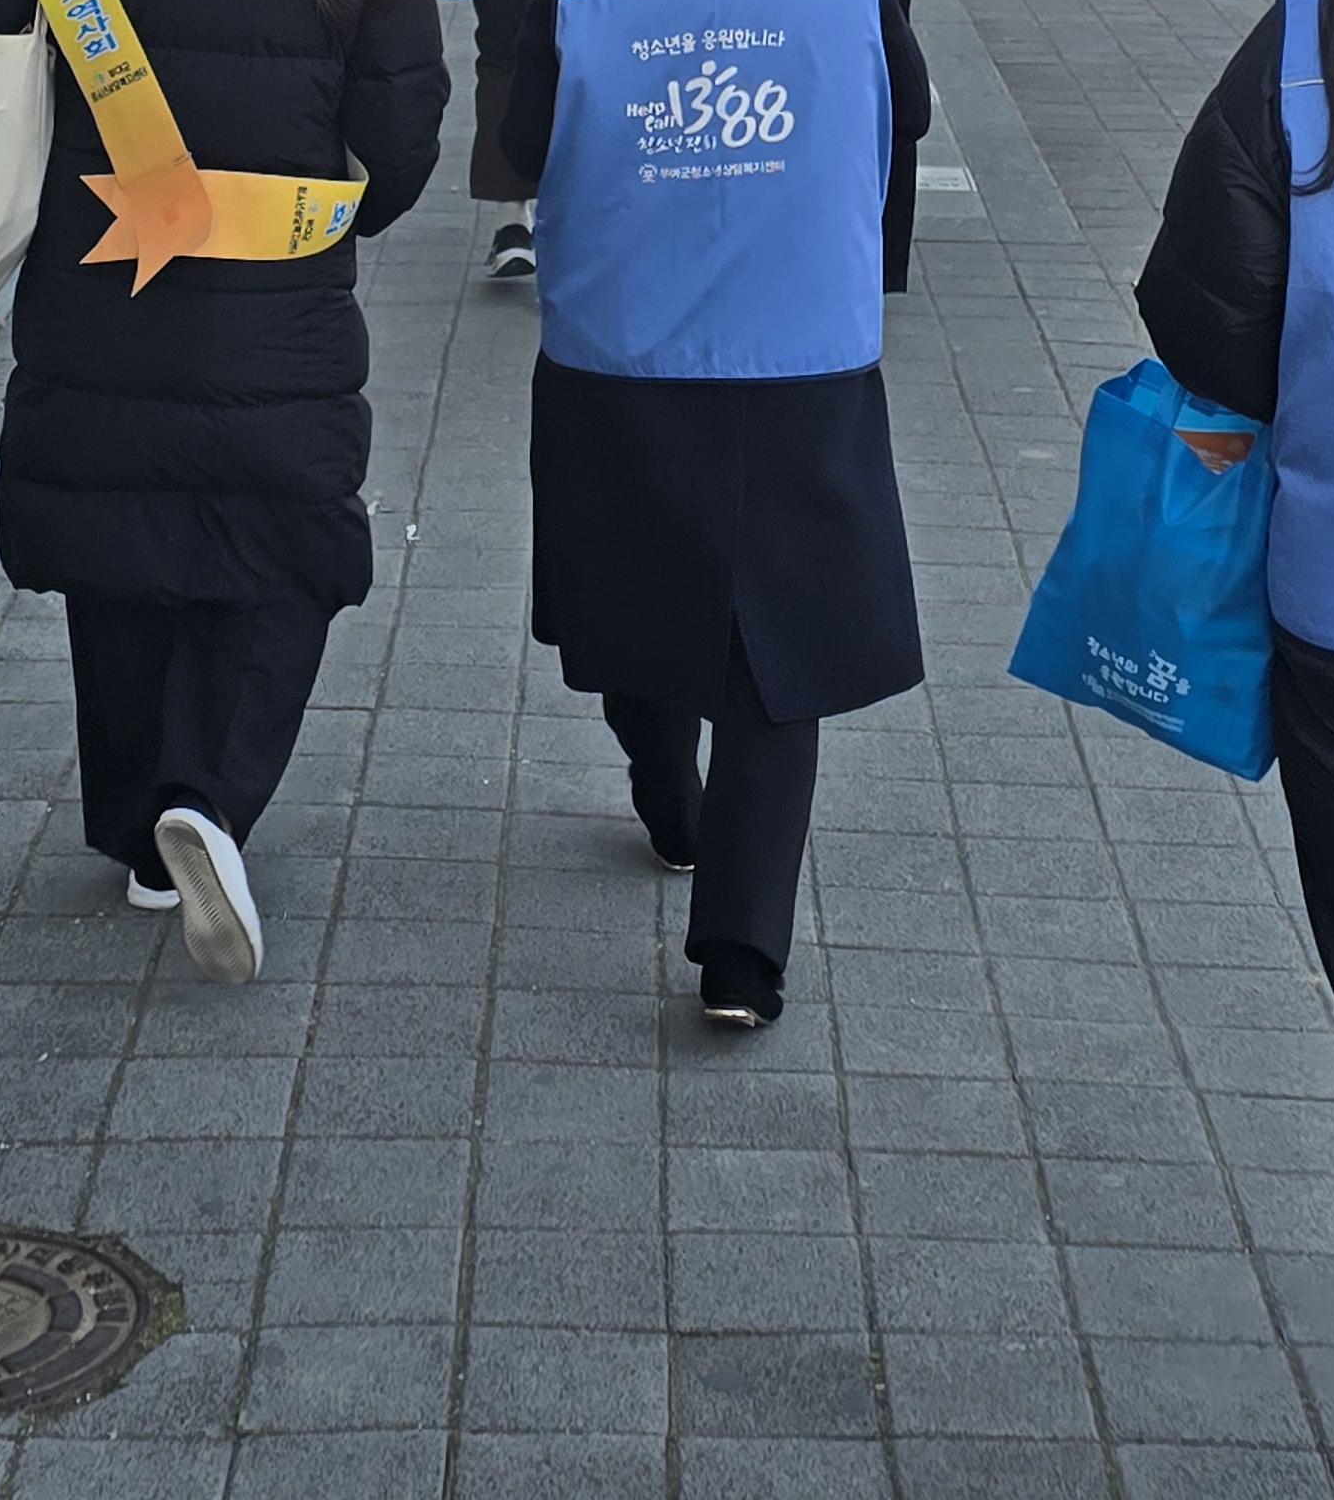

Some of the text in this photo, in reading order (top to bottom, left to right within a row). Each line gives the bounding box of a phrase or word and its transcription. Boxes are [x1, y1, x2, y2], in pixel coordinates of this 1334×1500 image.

[631, 28, 786, 61] 청소년을 응원합니다
[625, 100, 666, 118] Help
[668, 73, 796, 149] 1388
[1087, 636, 1192, 696] 청소년의 꿈을
[1099, 665, 1170, 705] 응원합니다
